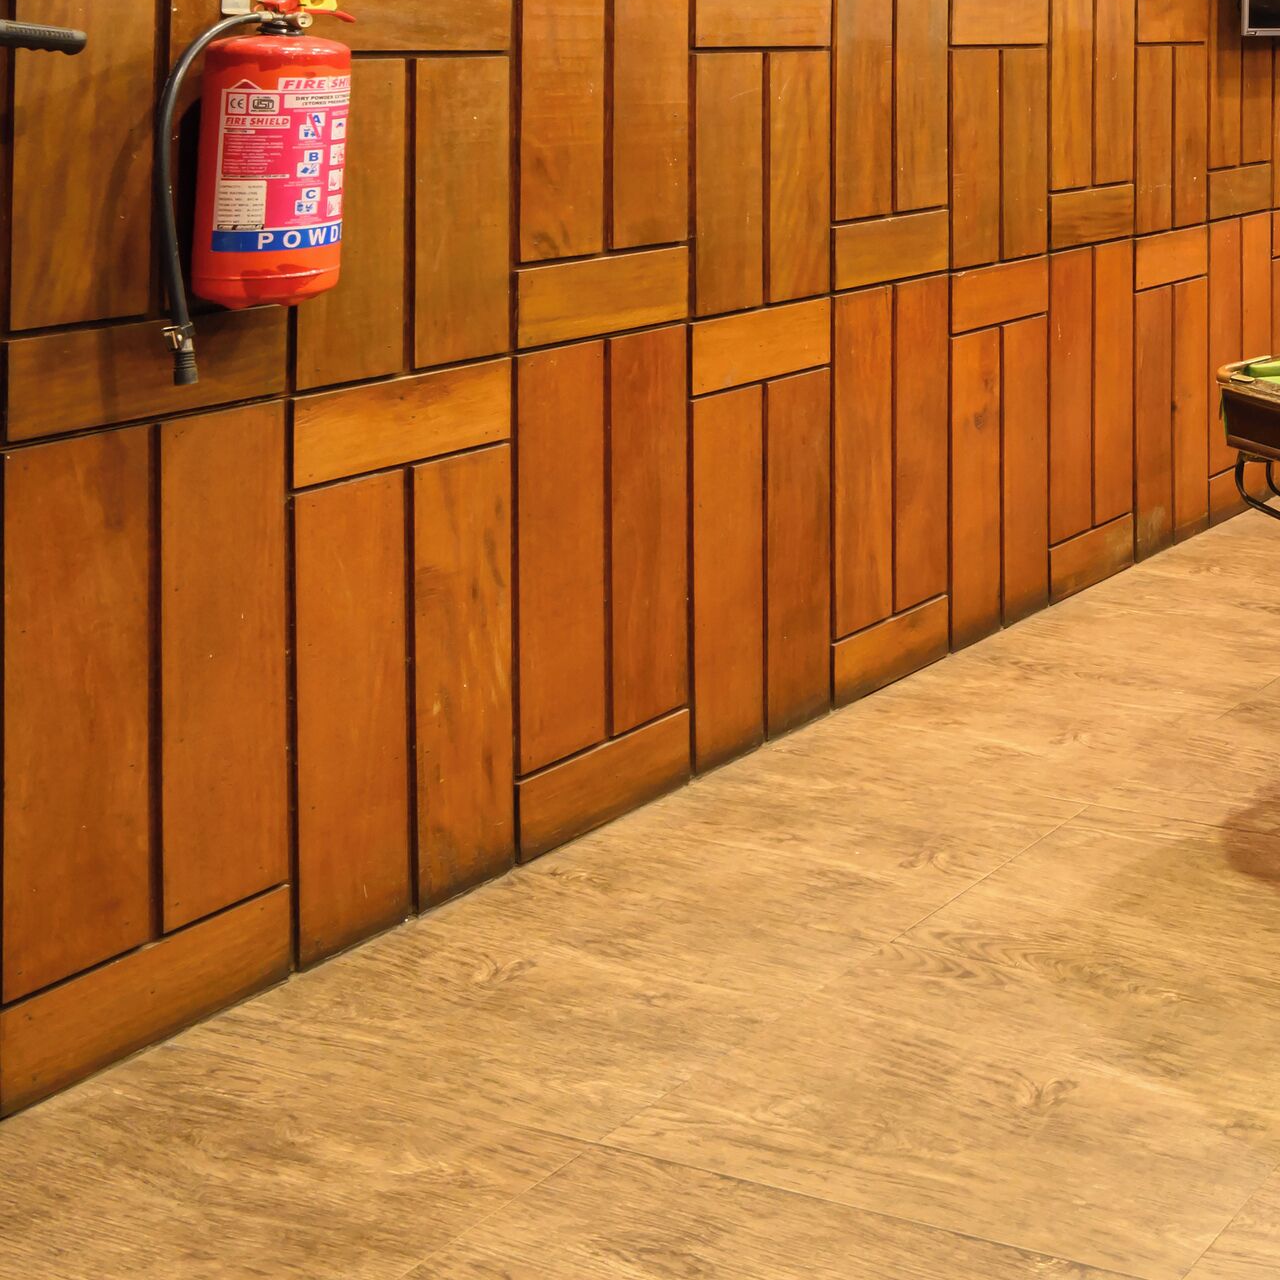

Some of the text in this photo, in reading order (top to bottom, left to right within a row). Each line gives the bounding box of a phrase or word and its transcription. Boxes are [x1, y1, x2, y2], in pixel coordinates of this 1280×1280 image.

[283, 80, 326, 89] FIRE
[309, 152, 318, 161] B
[306, 190, 316, 199] C
